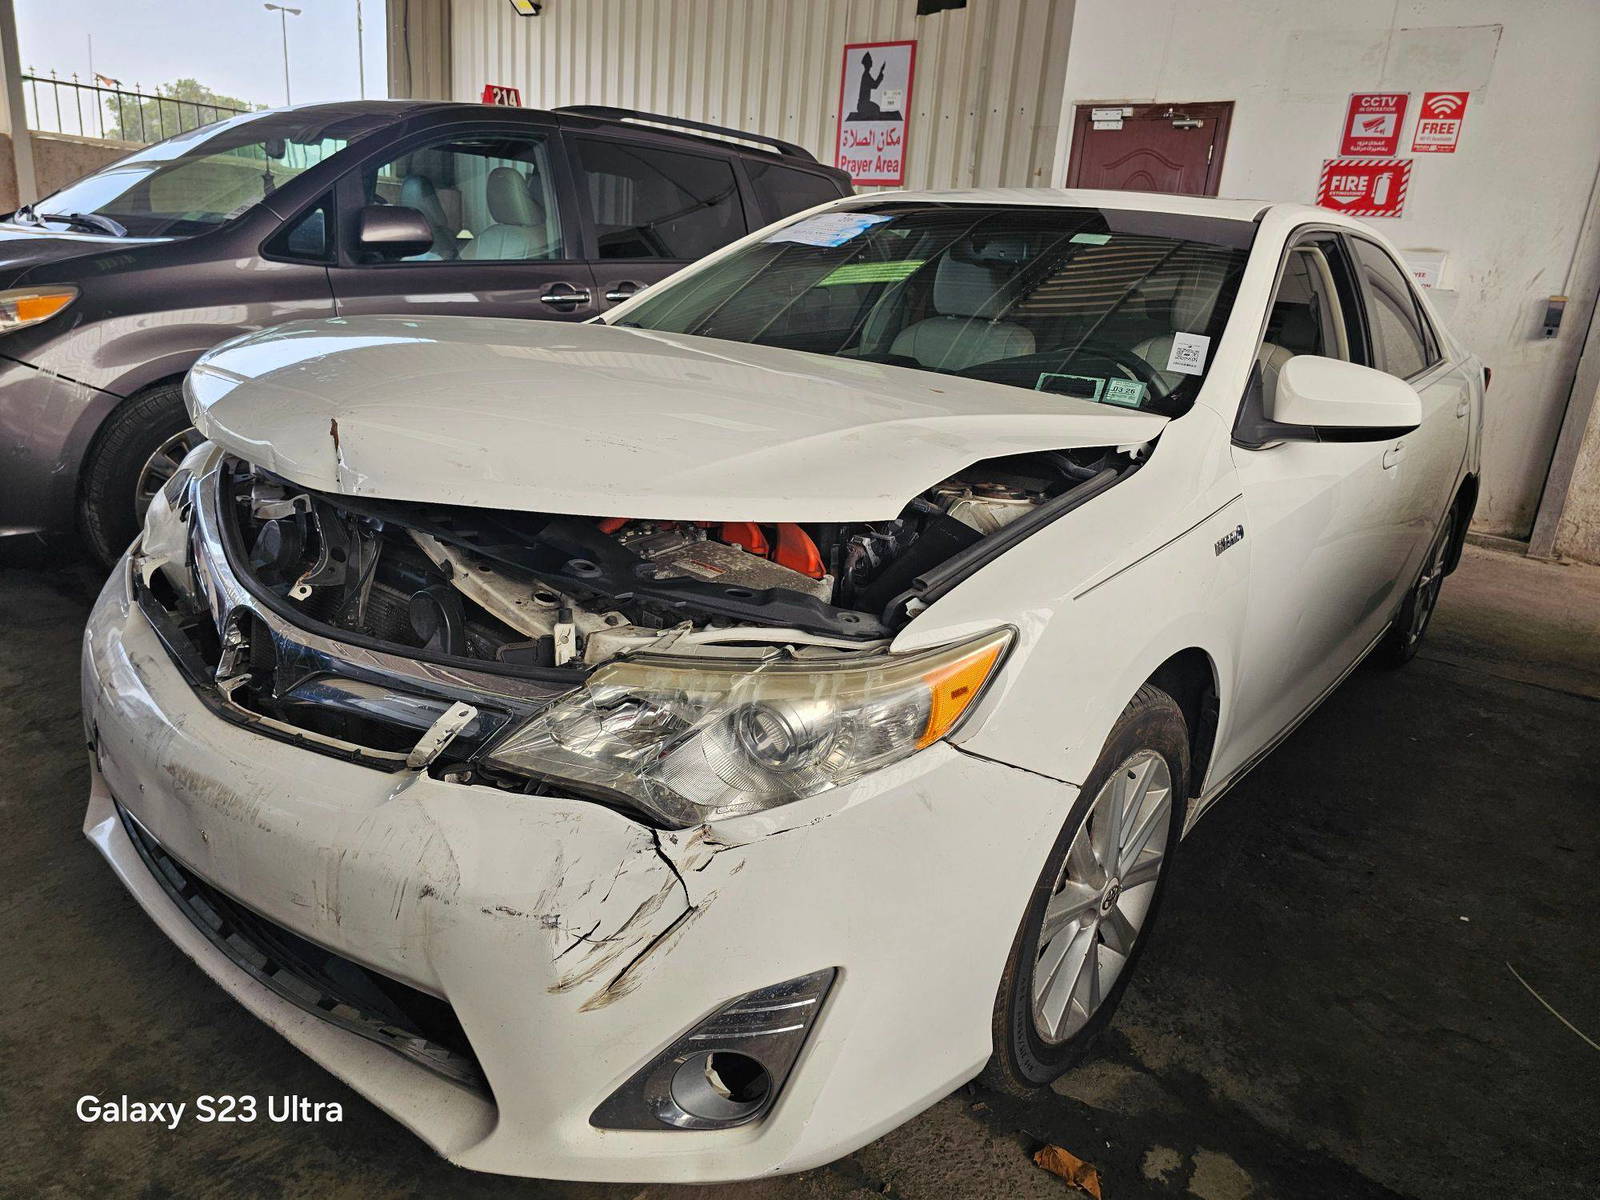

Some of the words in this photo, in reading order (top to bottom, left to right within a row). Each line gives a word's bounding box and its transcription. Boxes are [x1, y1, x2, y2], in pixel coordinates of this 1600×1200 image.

[493, 88, 517, 107] 214
[1361, 97, 1398, 107] CCTV
[1421, 123, 1456, 134] FREE
[843, 129, 875, 148] الصلاة
[877, 128, 901, 152] مكان
[841, 155, 872, 177] Prayer
[875, 155, 899, 173] Area
[1330, 176, 1369, 191] FIRE
